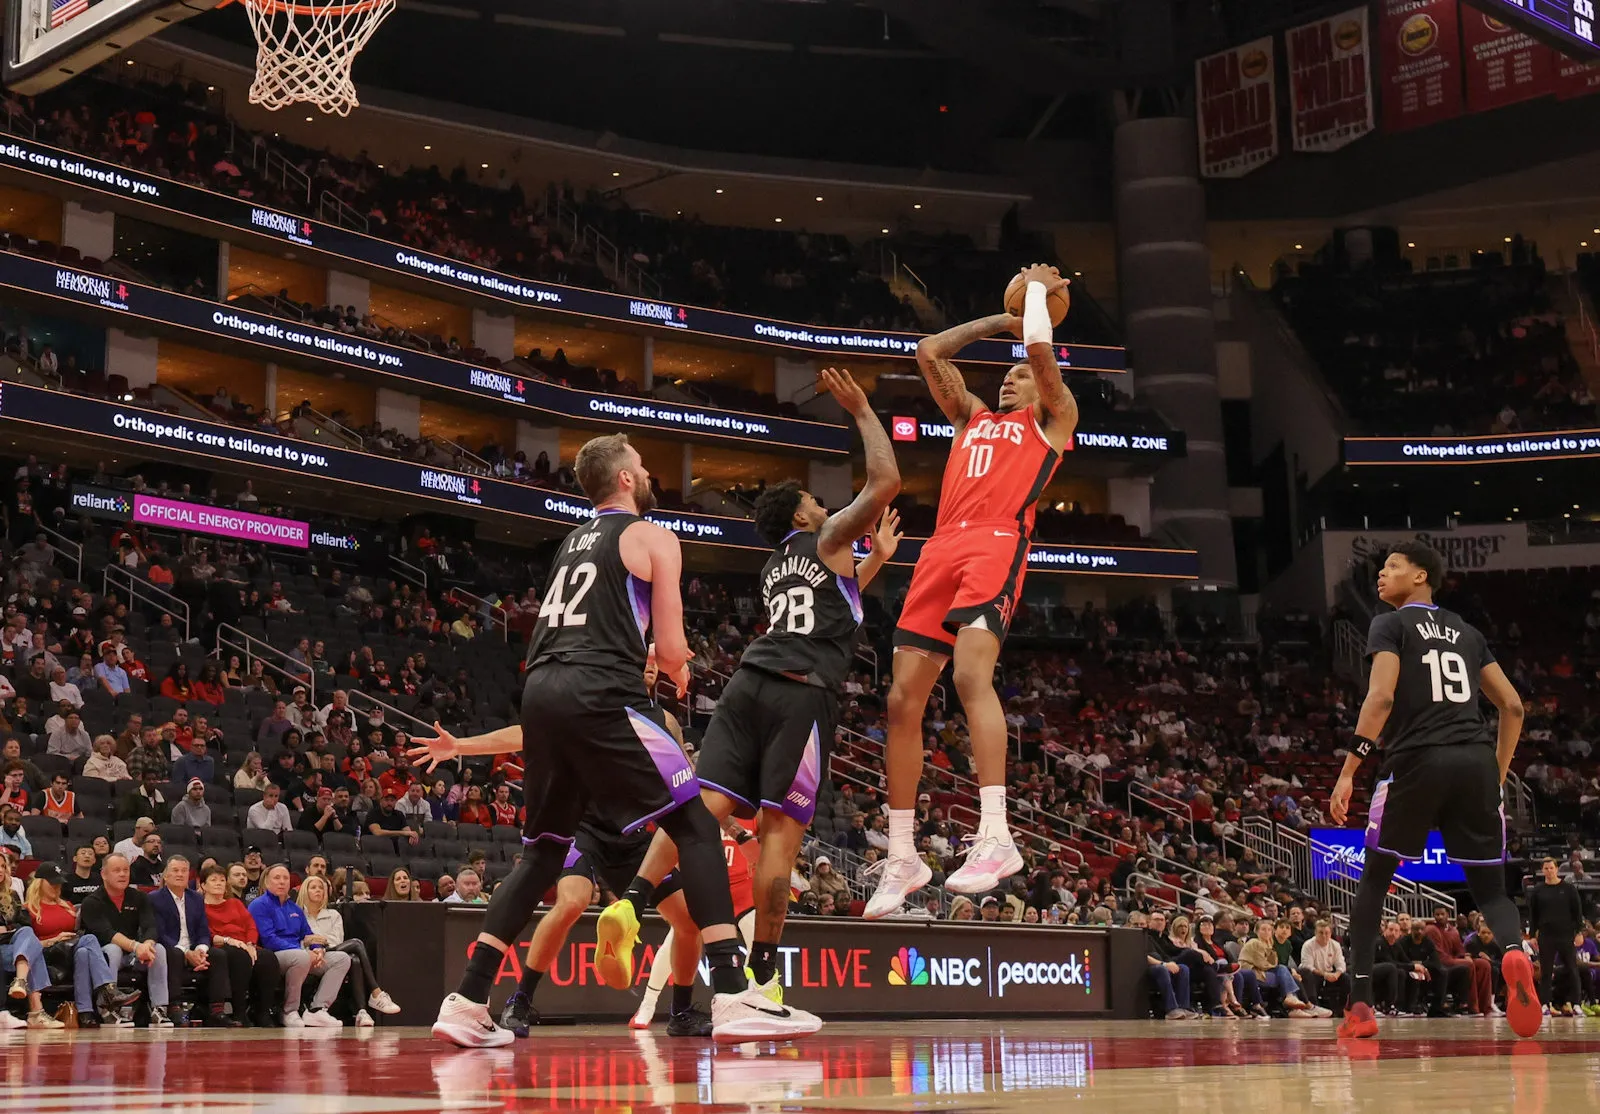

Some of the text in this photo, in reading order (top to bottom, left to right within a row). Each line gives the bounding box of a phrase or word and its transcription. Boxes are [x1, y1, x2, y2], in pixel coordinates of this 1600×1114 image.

[28, 153, 59, 169] care
[60, 159, 114, 184] tailored
[115, 174, 131, 189] to
[132, 181, 160, 197] you.
[251, 208, 298, 229] MEMORIAL
[251, 216, 297, 235] HERMANN
[56, 270, 110, 292] MEMORIAL
[396, 253, 562, 303] Orthopedic care tailored to you.
[55, 280, 109, 299] HERMANN
[629, 307, 673, 321] HERMANN
[630, 301, 673, 315] MEMORIAL
[213, 311, 404, 367] Orthopedic care tailored to you.
[754, 323, 918, 352] Orthopedic care tailored to yo
[470, 369, 511, 388] MEMORIAL
[470, 377, 510, 393] HERMANN
[589, 400, 770, 434] Orthopedic care tailored to you.
[113, 413, 329, 468] Orthopedic care tailored to you.
[919, 424, 956, 438] TUND
[1076, 433, 1169, 451] TUNDRA ZONE
[1402, 444, 1475, 458] Orthopedic
[1475, 444, 1505, 455] care
[1506, 438, 1561, 453] tailored
[1562, 438, 1578, 449] to
[966, 445, 994, 478] 10
[420, 470, 466, 488] MEMORIAL
[420, 478, 465, 494] HERMANN
[73, 493, 349, 549] reliant OFFICIAL ENERGY PROVIDER reliant
[544, 498, 597, 519] Orthoped
[680, 520, 696, 532] to
[695, 524, 722, 538] you.
[567, 532, 601, 554] LOVE
[1076, 554, 1090, 565] to
[1091, 556, 1117, 568] you.
[538, 562, 597, 628] 42
[1415, 621, 1460, 645] BAILEY
[1422, 648, 1471, 703] 19
[671, 768, 694, 789] UTAH
[786, 790, 811, 809] UTAH
[801, 948, 872, 988] LIVE
[930, 957, 982, 987] NBC
[997, 953, 1084, 998] peacock
